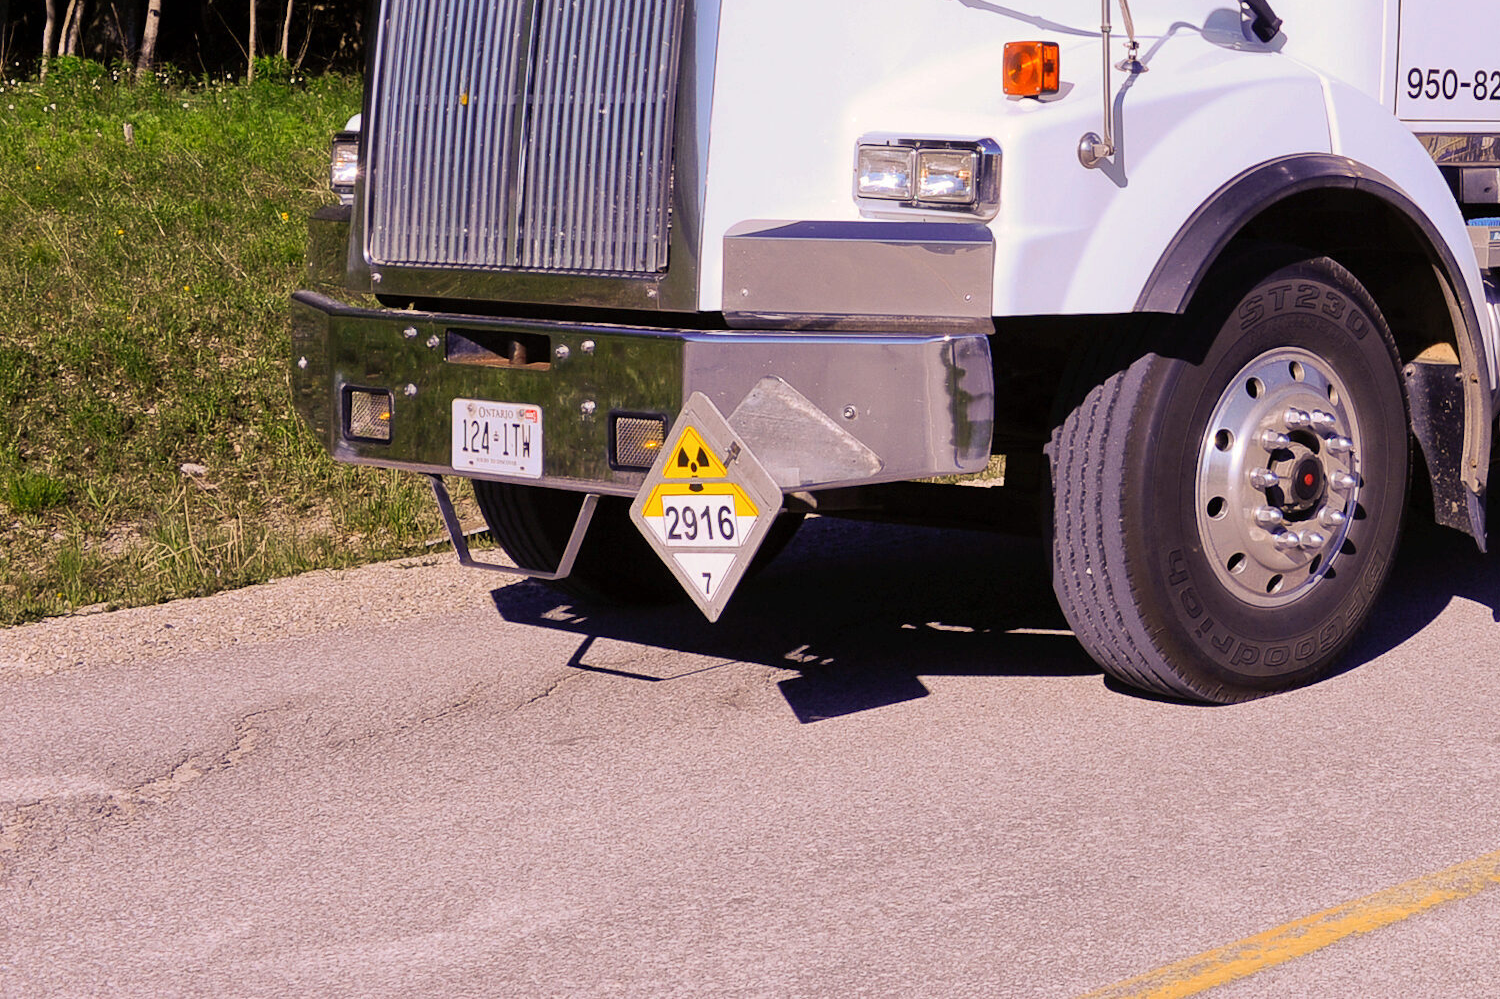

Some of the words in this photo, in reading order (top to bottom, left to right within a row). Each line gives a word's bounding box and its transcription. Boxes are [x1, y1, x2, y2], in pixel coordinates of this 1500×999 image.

[1237, 283, 1370, 340] ST230
[462, 418, 489, 455] 124
[665, 505, 735, 541] 2916
[702, 573, 712, 594] 7
